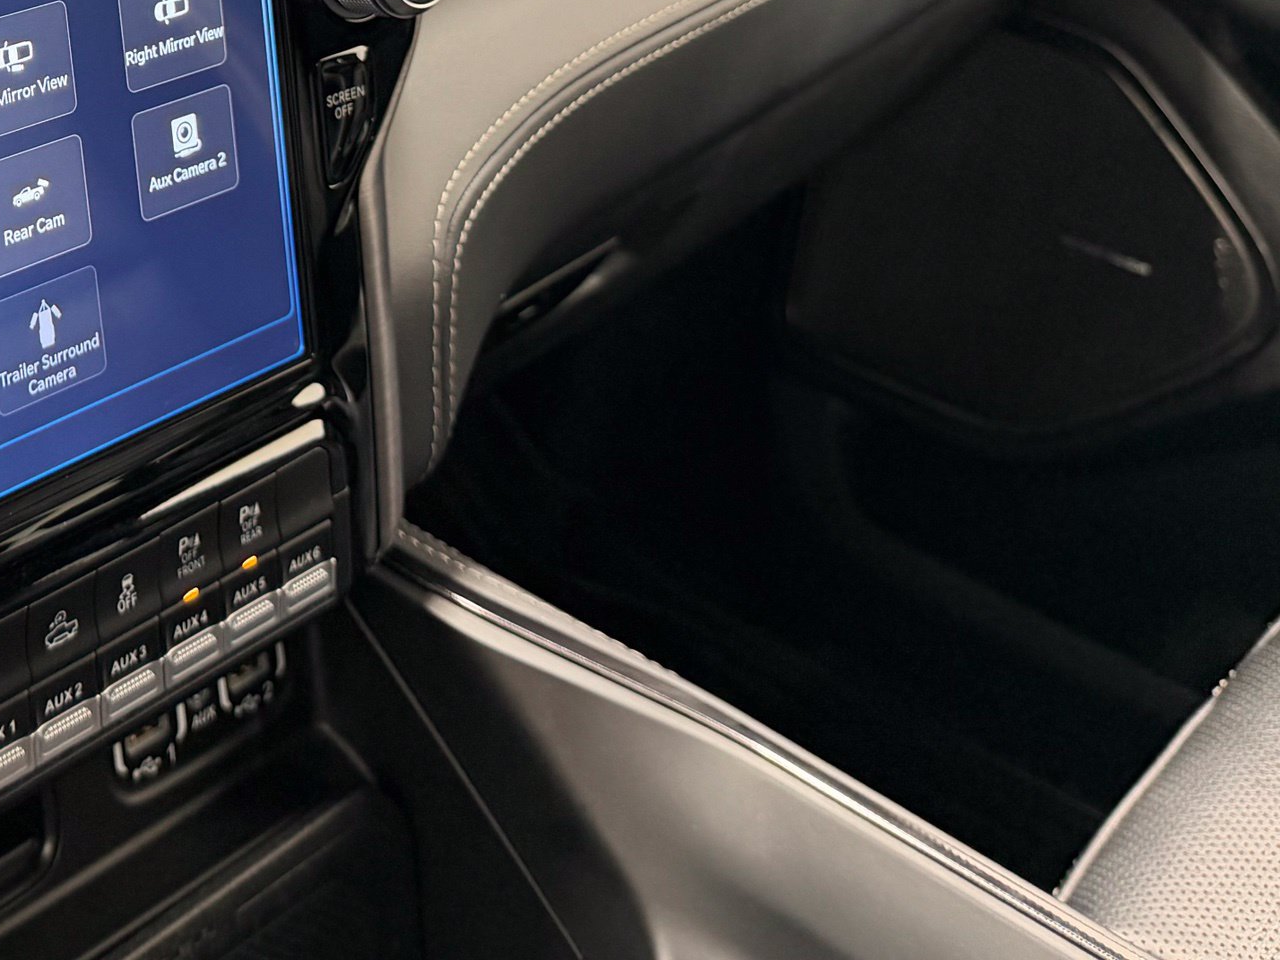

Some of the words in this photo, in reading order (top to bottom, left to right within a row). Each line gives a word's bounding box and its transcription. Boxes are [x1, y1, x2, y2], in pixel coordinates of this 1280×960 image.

[124, 45, 159, 68] Right
[158, 35, 195, 61] Mirror
[194, 23, 225, 47] View
[36, 73, 69, 98] View
[326, 84, 365, 108] SCREEN
[334, 102, 354, 120] OFF
[148, 169, 173, 194] Aux
[172, 157, 217, 184] Camera
[216, 151, 228, 169] 2
[3, 221, 36, 248] Rear
[35, 211, 66, 237] Cam
[40, 331, 101, 370] Surround
[27, 365, 77, 396] Camera
[177, 554, 206, 579] FRONT
[288, 549, 312, 574] AUX
[116, 592, 138, 614] OFF
[232, 581, 258, 605] AUX
[173, 614, 200, 640] AUX
[110, 650, 138, 676] AUX
[137, 644, 148, 661] 3
[44, 688, 73, 716] AUX
[71, 682, 83, 700] 2
[6, 720, 16, 736] 1
